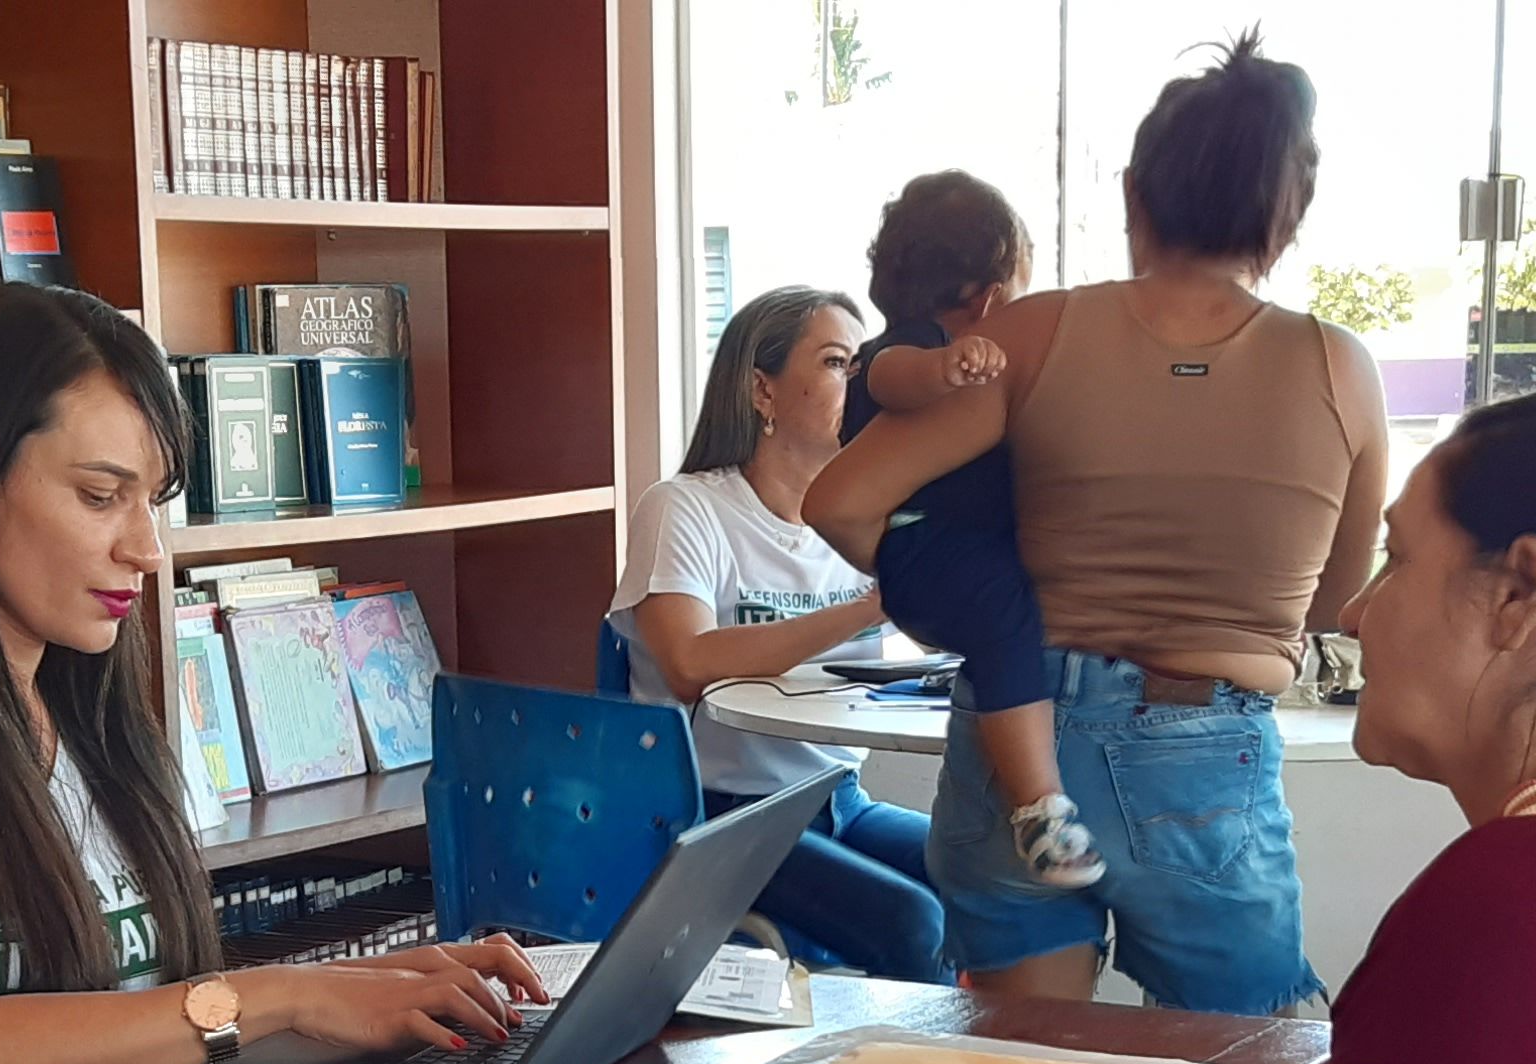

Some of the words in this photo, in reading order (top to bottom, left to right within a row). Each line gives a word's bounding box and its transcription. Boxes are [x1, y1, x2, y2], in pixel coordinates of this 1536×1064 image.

[300, 296, 373, 319] ATLAS
[300, 331, 374, 345] UNIVERSAL
[738, 586, 824, 609] DFENSORIA
